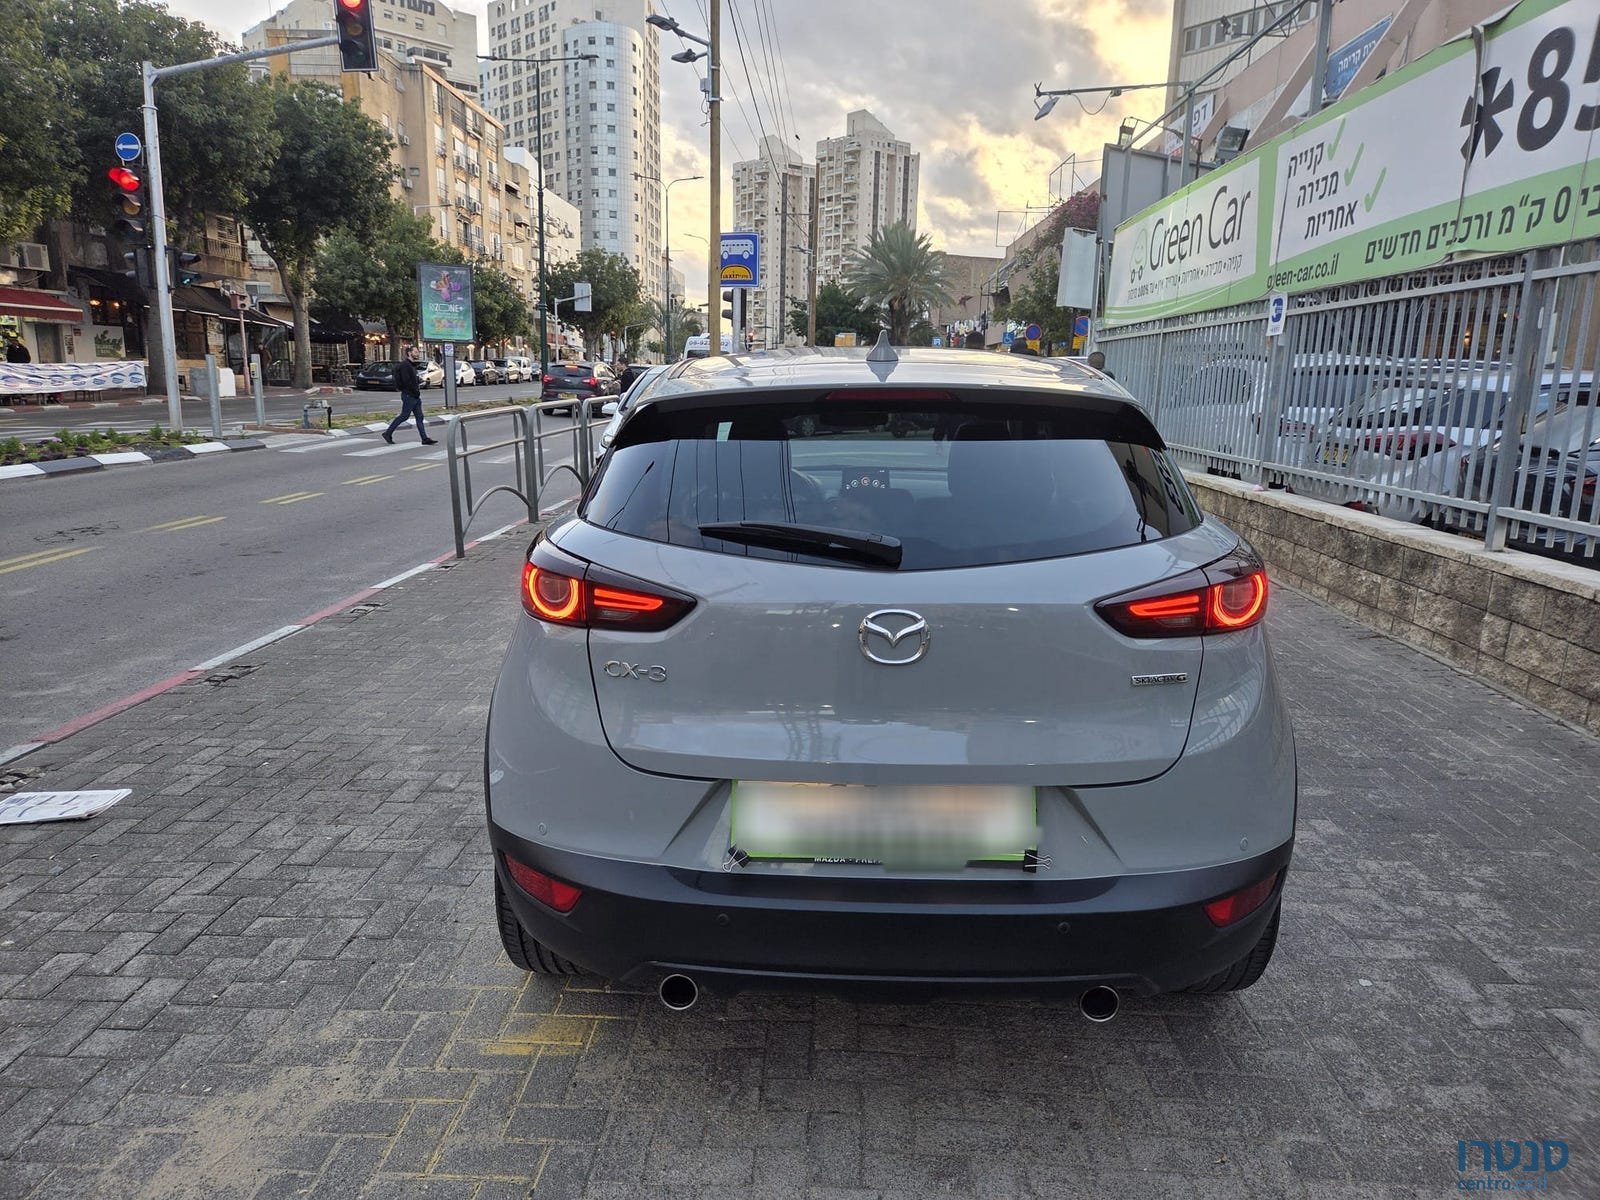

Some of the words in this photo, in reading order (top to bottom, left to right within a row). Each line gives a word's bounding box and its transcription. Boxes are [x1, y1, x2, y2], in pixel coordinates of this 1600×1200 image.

[1288, 142, 1325, 179] קנייה
[1297, 171, 1339, 208] מכירה
[1150, 213, 1203, 271] Green
[1208, 185, 1251, 250] Car
[1304, 200, 1359, 240] אחריות
[1426, 210, 1493, 250] ורכבים
[1365, 229, 1422, 264] חדשים
[604, 660, 667, 682] CX-3
